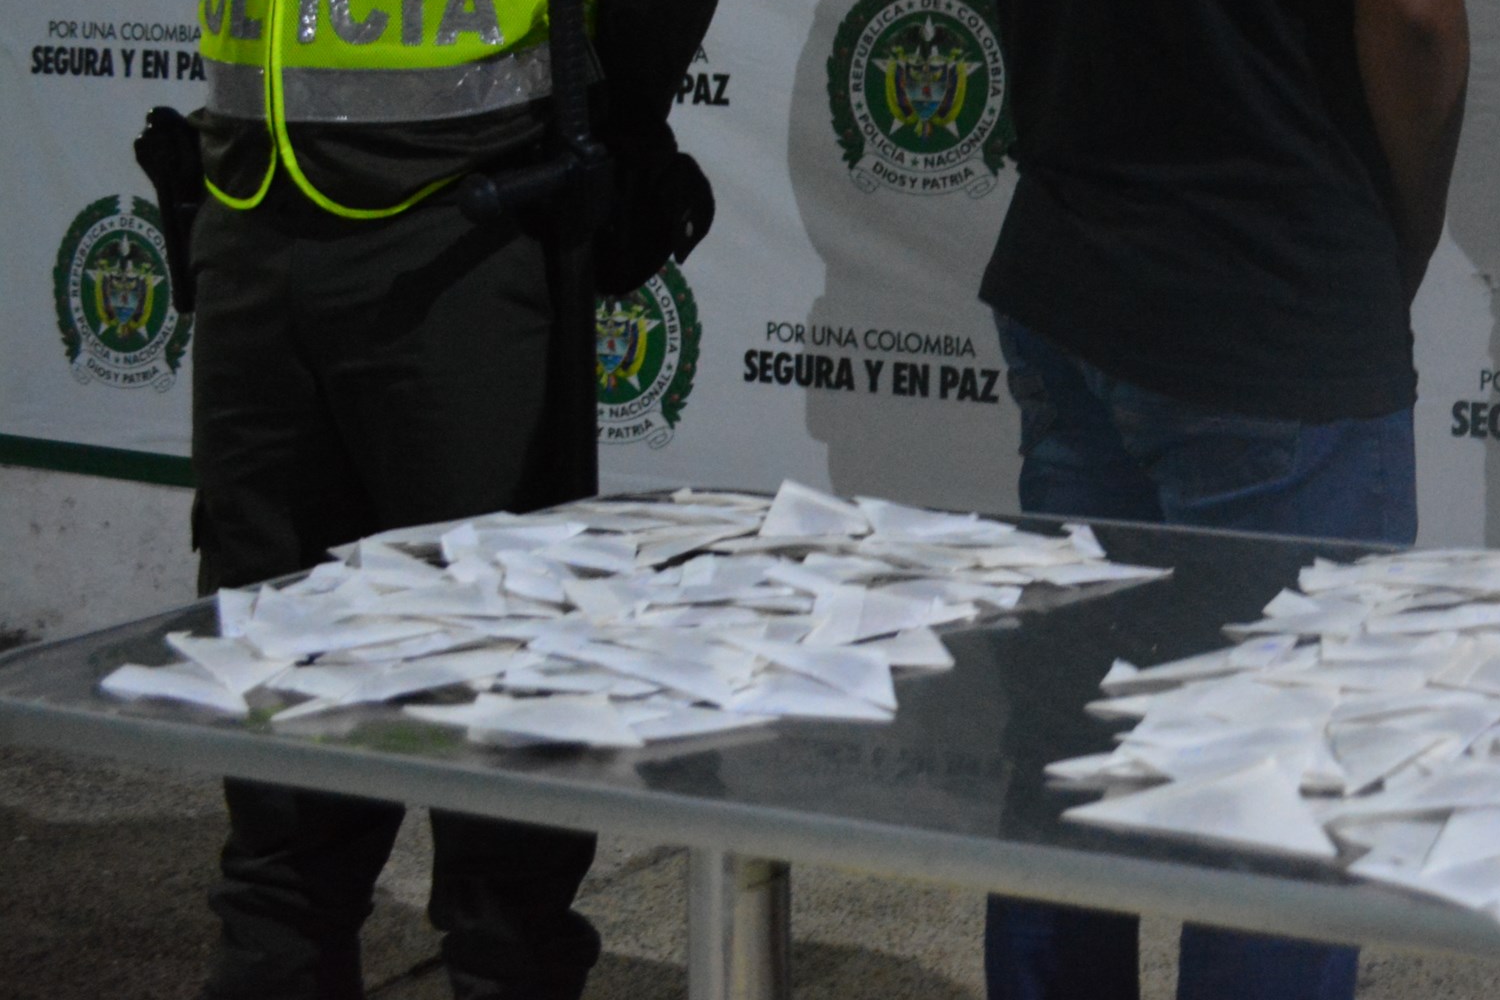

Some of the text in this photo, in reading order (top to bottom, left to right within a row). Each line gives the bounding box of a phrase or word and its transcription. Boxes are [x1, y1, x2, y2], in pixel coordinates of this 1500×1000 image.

[48, 21, 79, 40] POR
[81, 23, 118, 41] UNA
[30, 45, 207, 82] SEGURA Y EN PA
[765, 320, 977, 359] POR UNA COLOMBIA
[743, 348, 1000, 404] SEGURA Y EN PAZ
